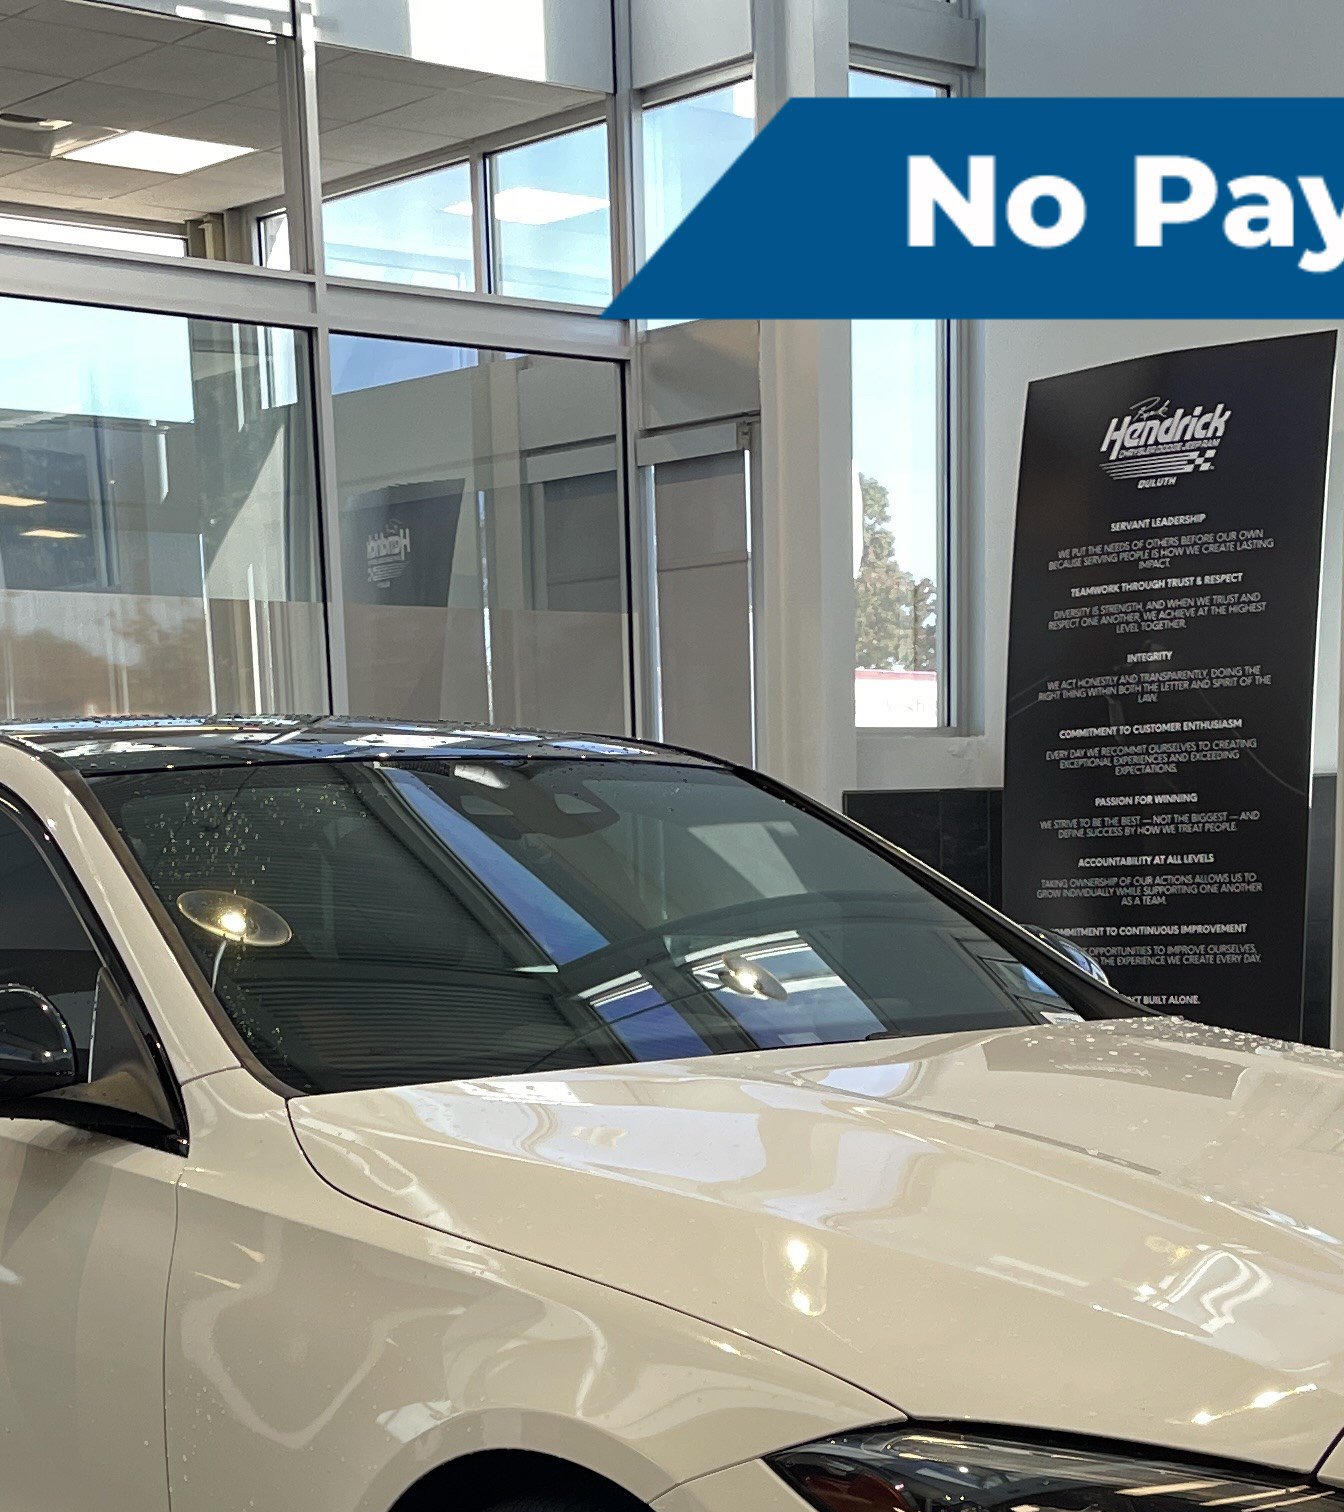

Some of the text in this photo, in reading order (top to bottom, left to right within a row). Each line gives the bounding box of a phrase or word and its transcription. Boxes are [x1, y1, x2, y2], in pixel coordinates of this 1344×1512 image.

[1100, 403, 1232, 460] Hendrick
[1137, 476, 1177, 489] DULUTH
[1110, 514, 1206, 531] SERVANT LEADERSHIP
[1071, 584, 1120, 597] TEAMWORK
[1121, 580, 1166, 592] THROUGH
[1166, 577, 1195, 588] TRUST
[1204, 573, 1243, 585] RESPECT
[1126, 651, 1173, 662] INTEGRITY
[1059, 719, 1243, 738] COMMITMENT TO CUSTOMER ENTHUSIASM
[1095, 793, 1198, 806] PASSION FOR WINNING
[1078, 854, 1215, 867] ACCOUNTABILITY AT ALL LEVELS
[1105, 924, 1247, 935] TO CONTINUOUS IMPROVEMENT
[1143, 996, 1167, 1004] BUILT
